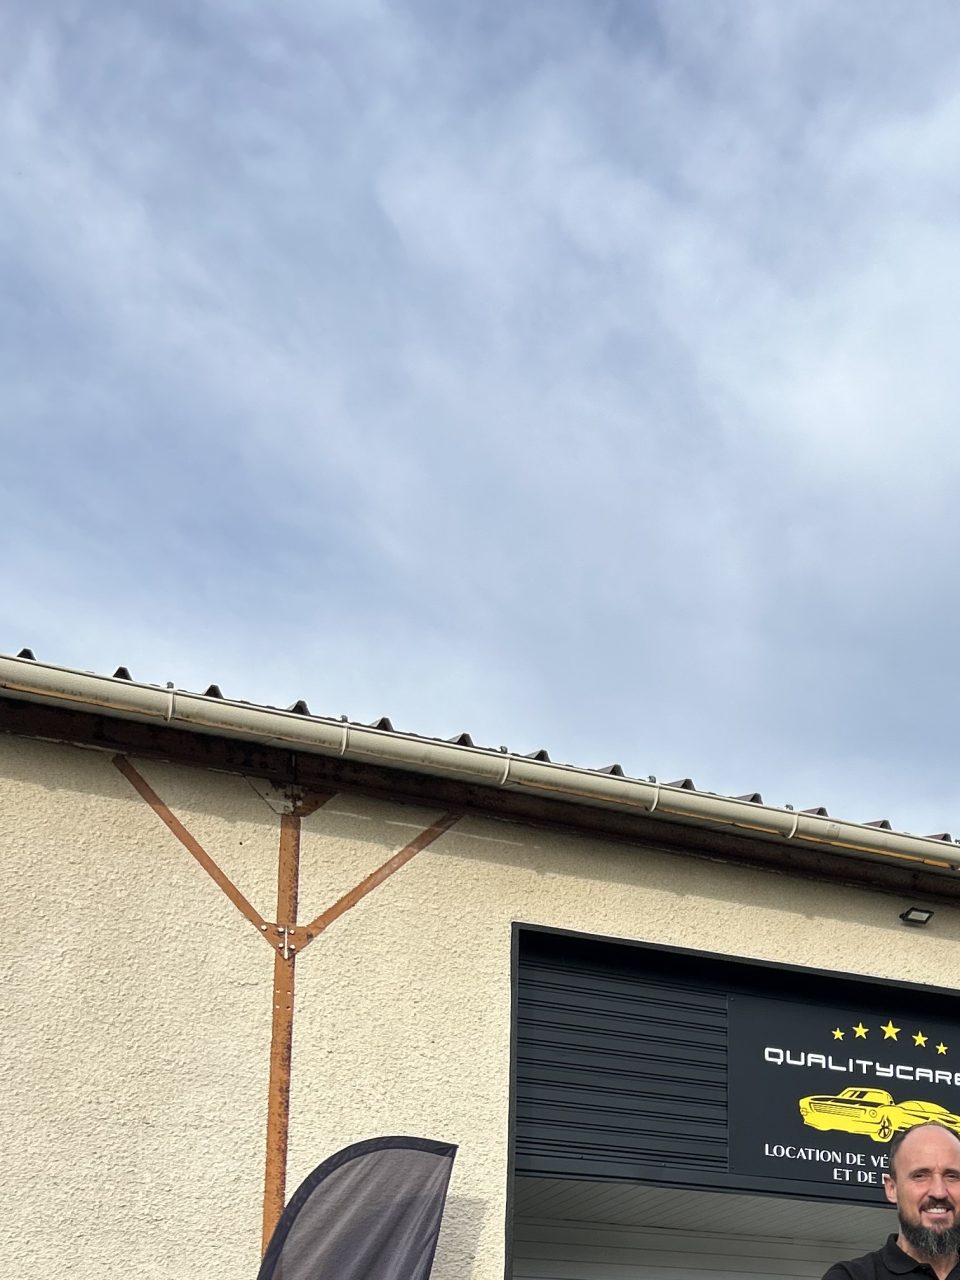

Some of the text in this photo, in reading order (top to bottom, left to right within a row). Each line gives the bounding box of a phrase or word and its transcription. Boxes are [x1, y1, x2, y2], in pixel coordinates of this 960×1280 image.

[764, 1143, 842, 1164] LOCATION
[845, 1152, 866, 1167] DE
[833, 1168, 853, 1182] ET
[857, 1170, 878, 1185] DE
